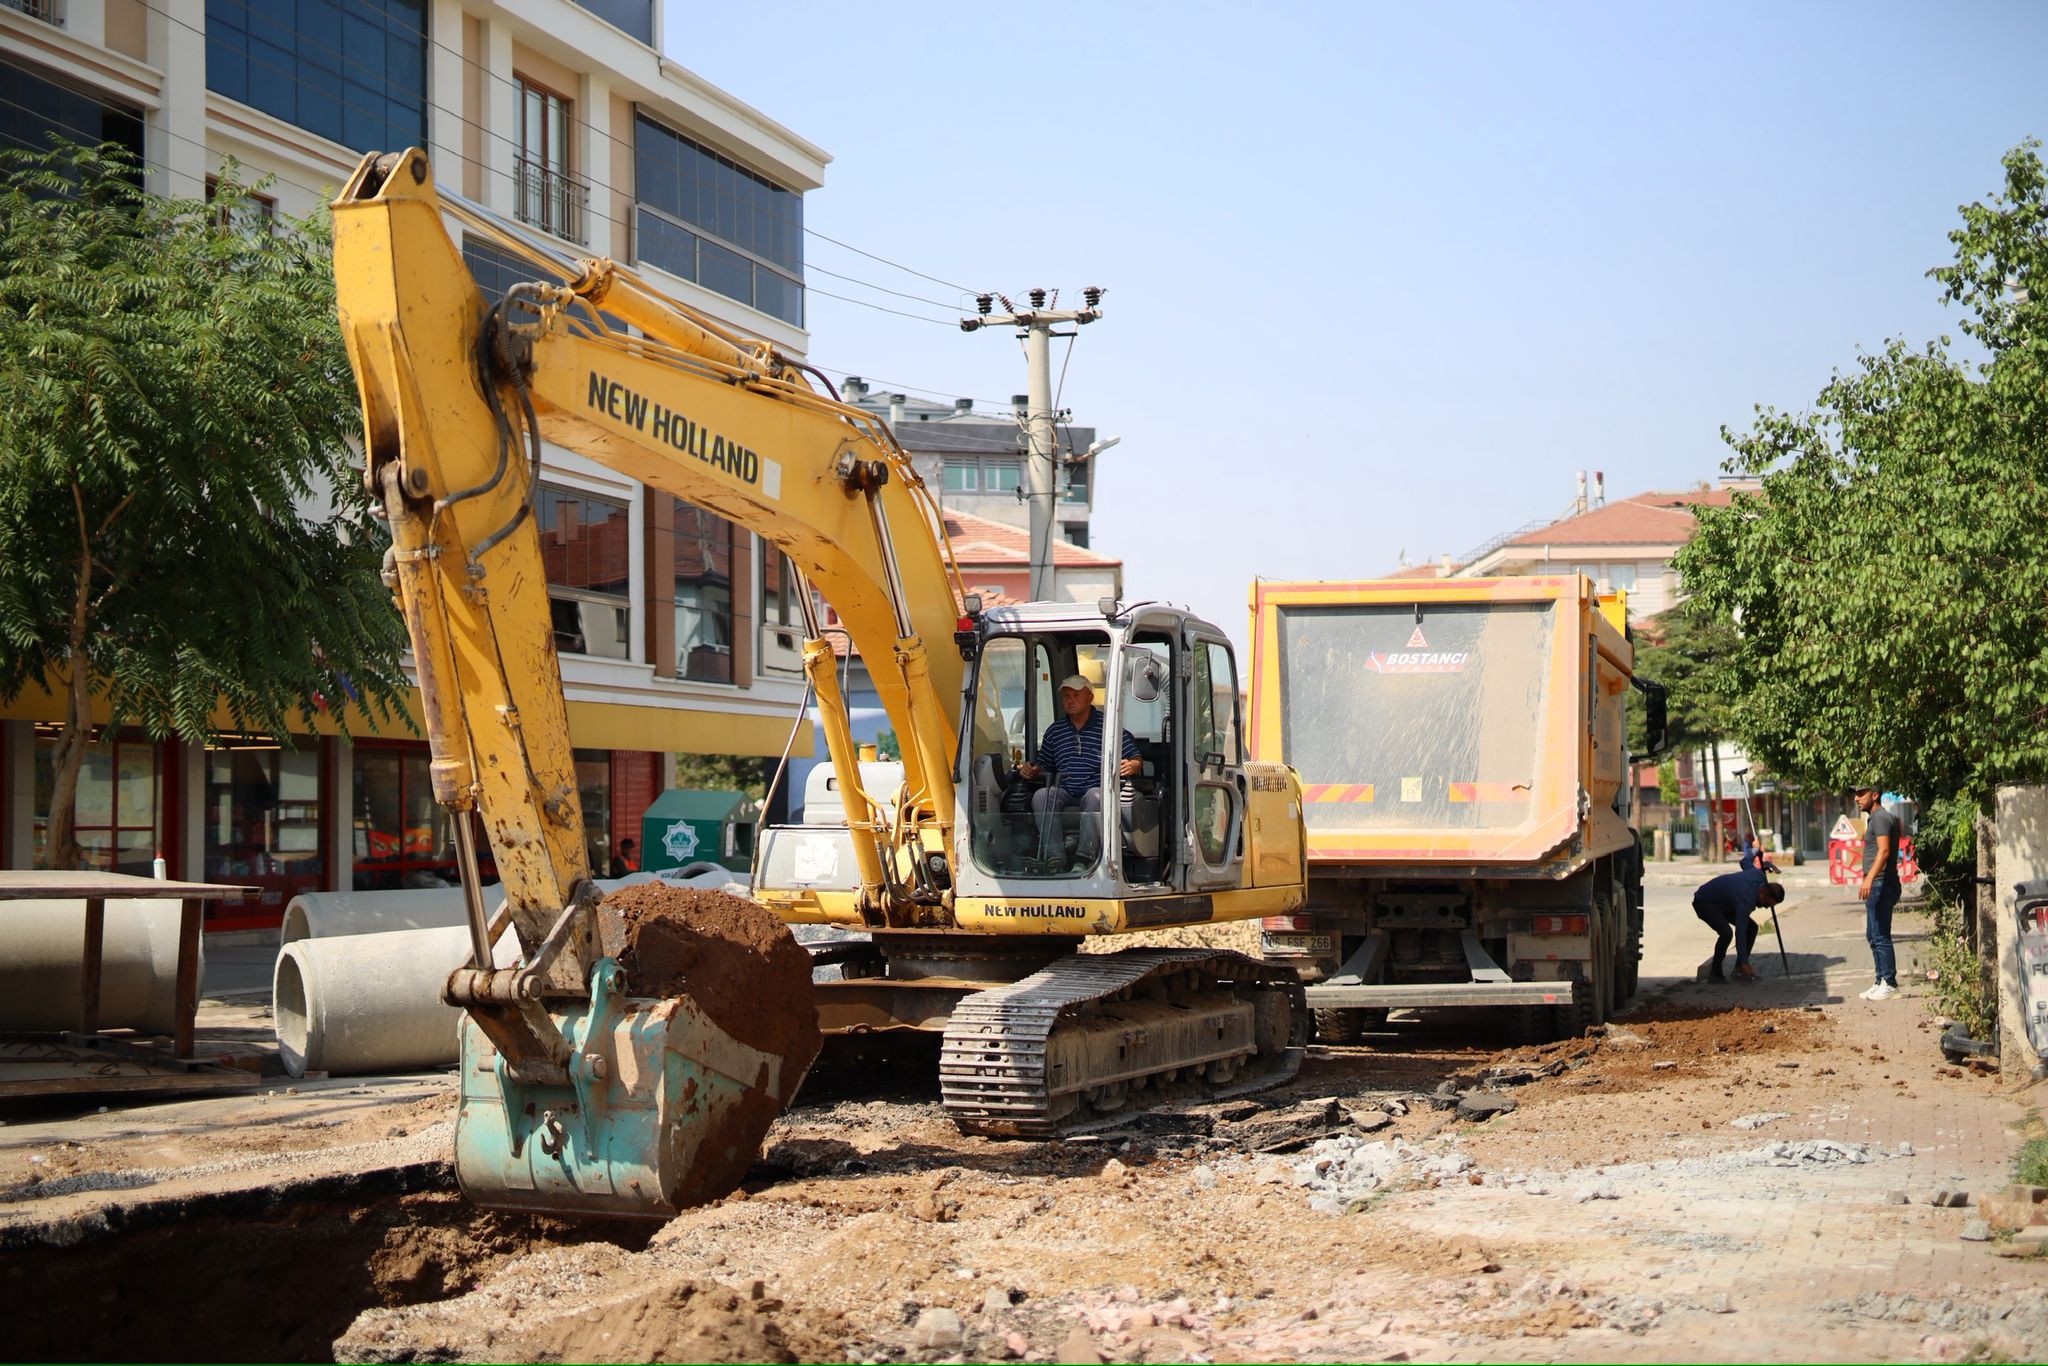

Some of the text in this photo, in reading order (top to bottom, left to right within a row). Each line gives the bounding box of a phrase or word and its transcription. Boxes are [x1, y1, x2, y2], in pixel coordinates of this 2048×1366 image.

[588, 370, 759, 485] NEW HOLLAND
[1386, 652, 1468, 665] BOSTANCI
[984, 904, 1086, 918] NEW HOLLAND
[1311, 937, 1330, 949] 266
